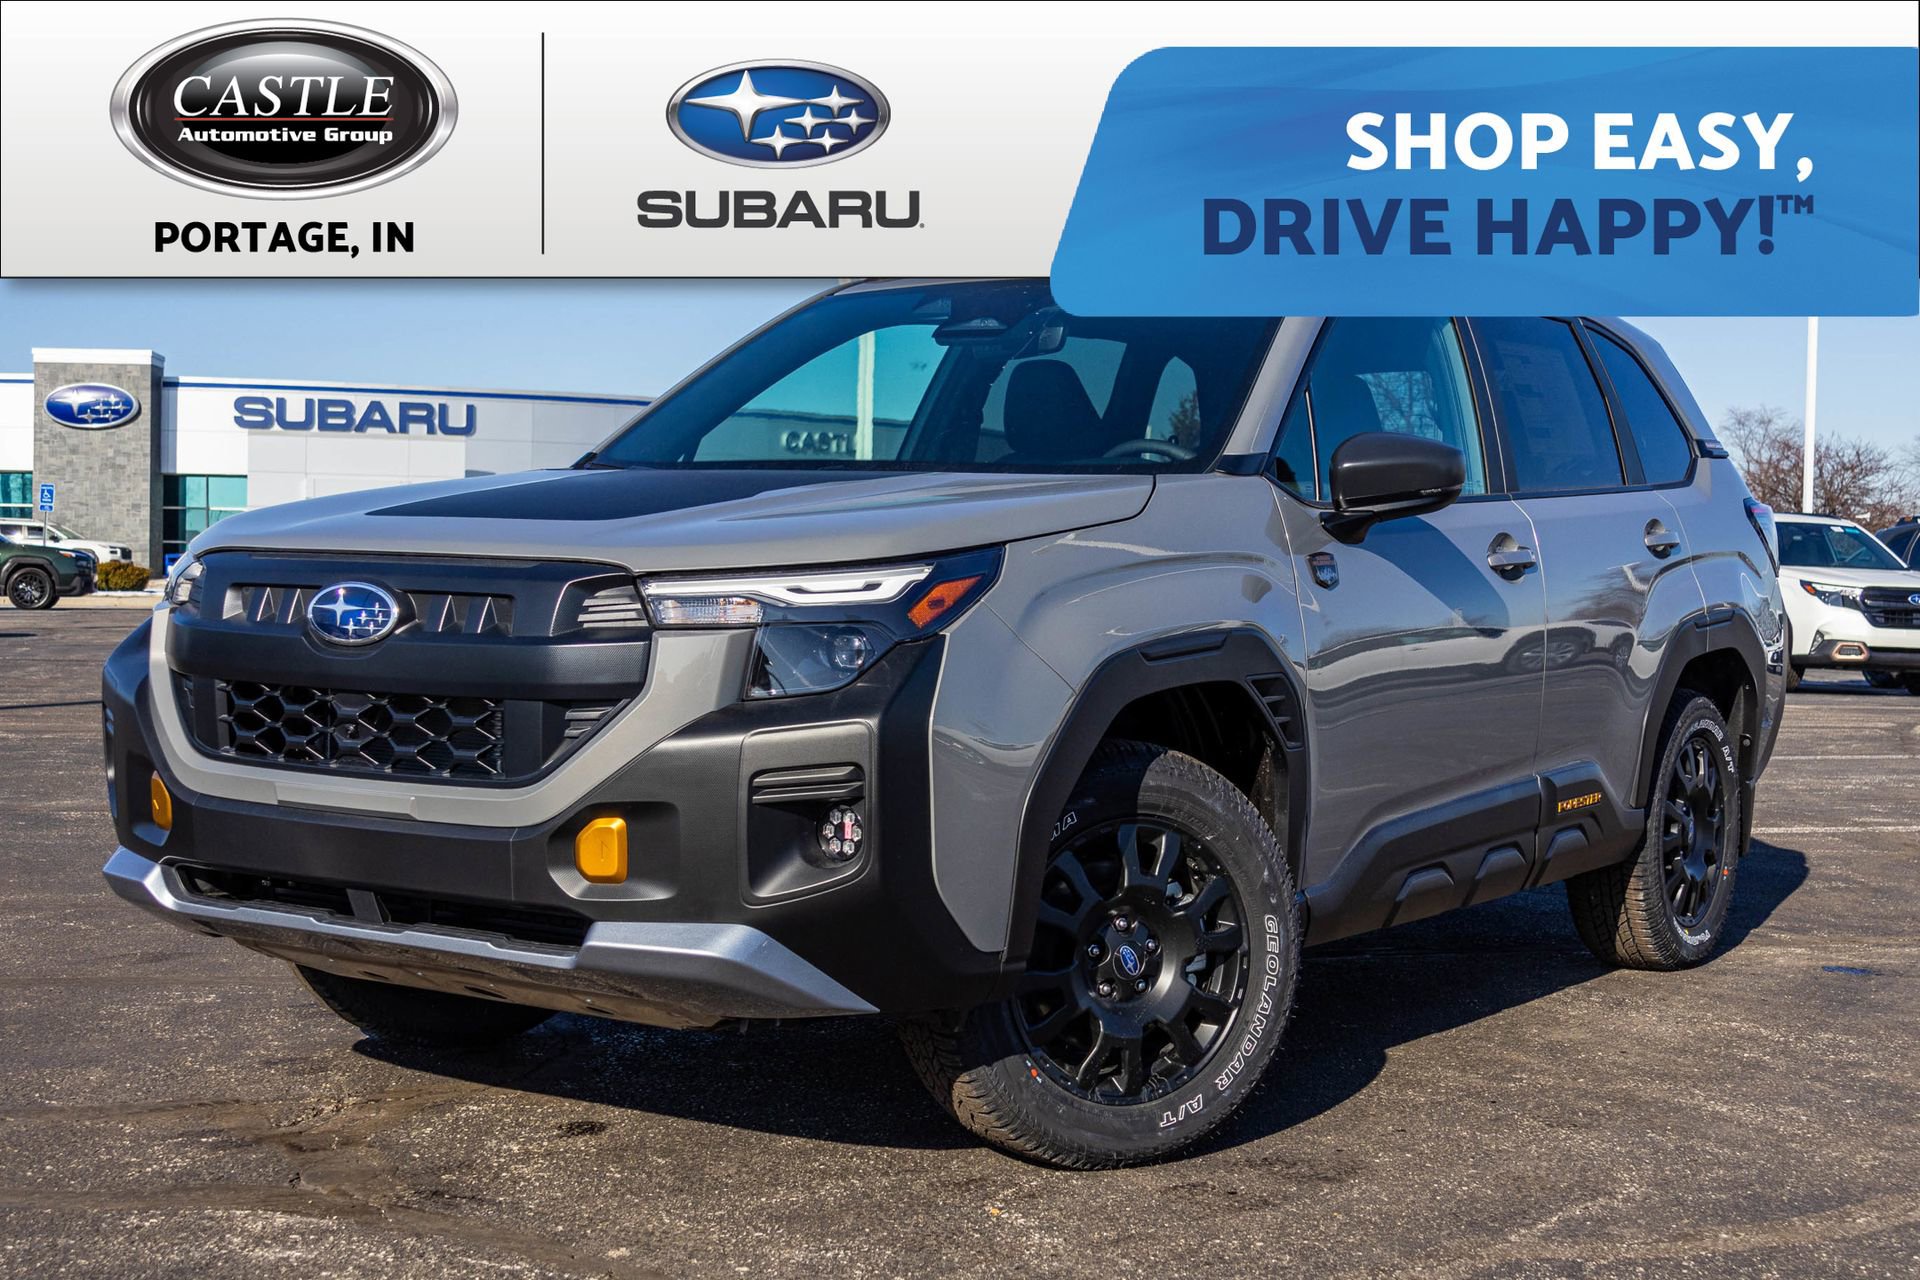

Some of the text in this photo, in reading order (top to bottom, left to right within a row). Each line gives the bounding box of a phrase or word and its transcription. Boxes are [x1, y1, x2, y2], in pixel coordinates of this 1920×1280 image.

[233, 395, 477, 437] SUBARU
[1160, 914, 1280, 1128] GEOLANDAR A/T
